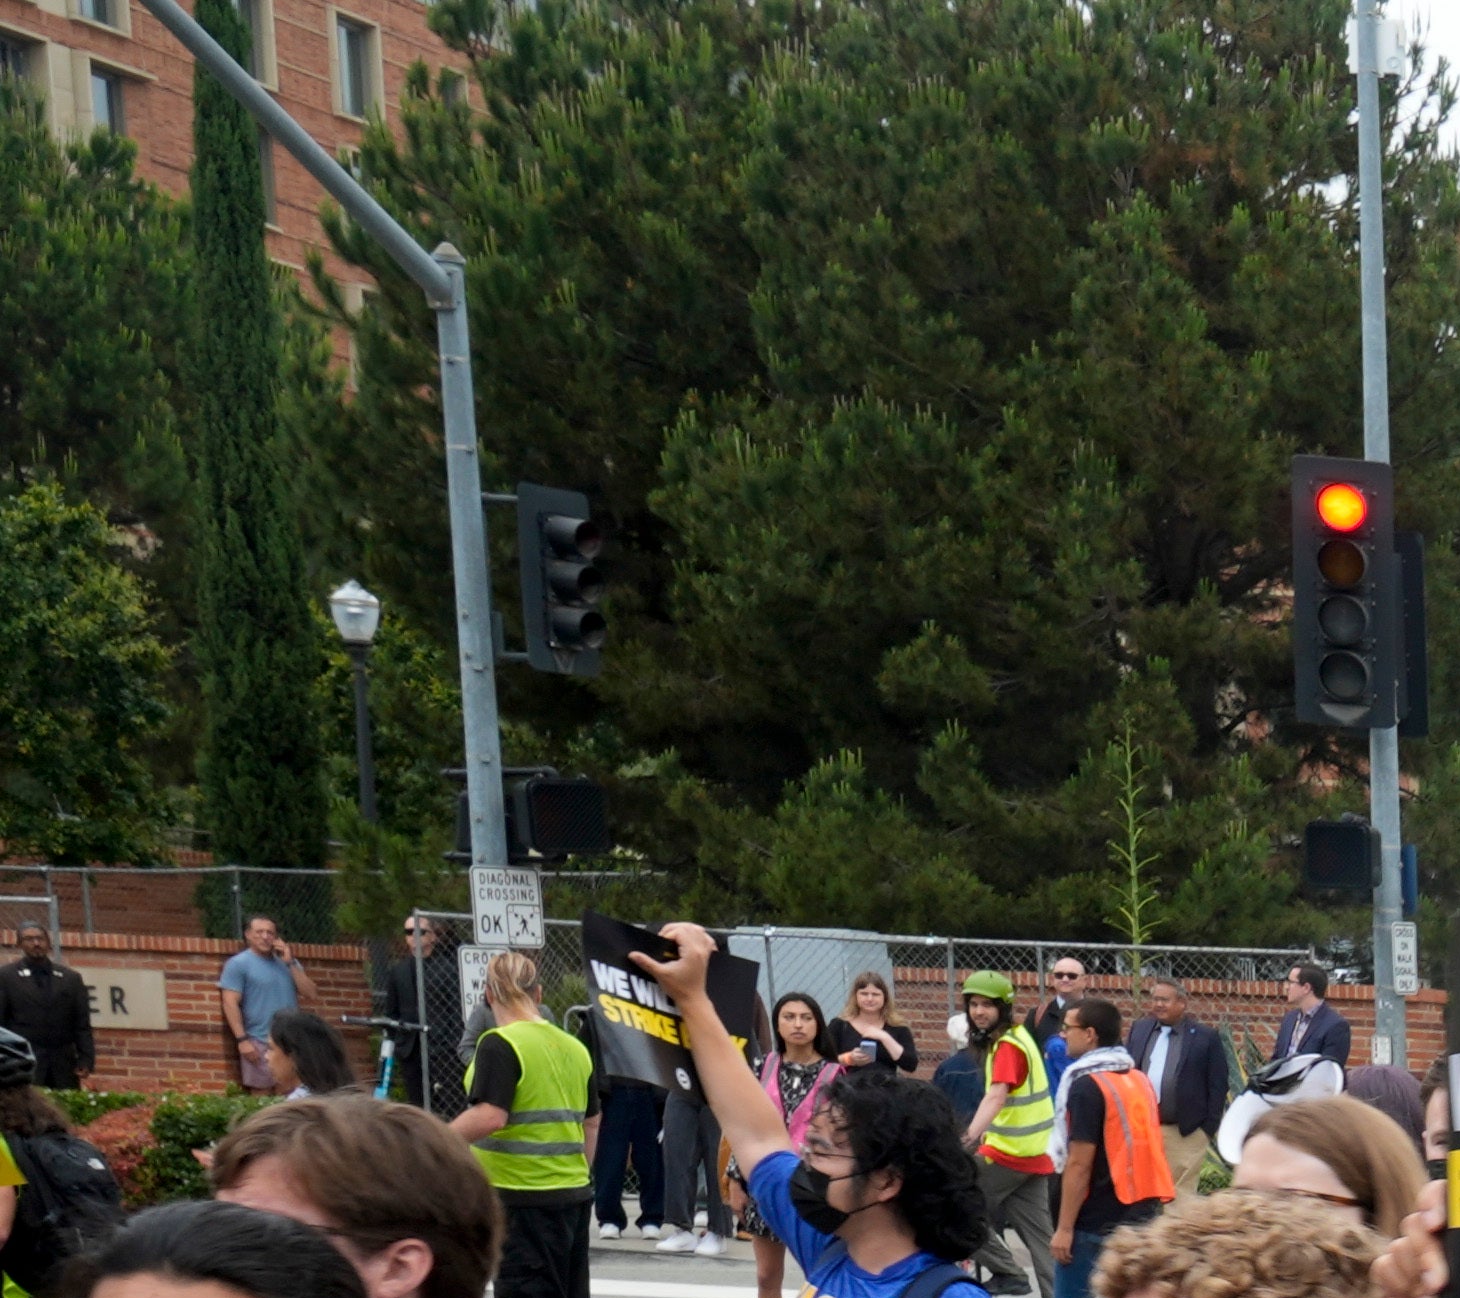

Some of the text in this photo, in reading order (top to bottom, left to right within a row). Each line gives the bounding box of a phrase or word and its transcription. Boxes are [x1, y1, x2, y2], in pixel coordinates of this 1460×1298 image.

[479, 872, 531, 886] DIAGONAL
[479, 888, 534, 901] CROSSING
[481, 914, 503, 934] OK
[1395, 928, 1413, 938] CROSS
[464, 952, 491, 964] CRO
[590, 959, 681, 1017] WE WIL
[599, 994, 680, 1045] STRIKE
